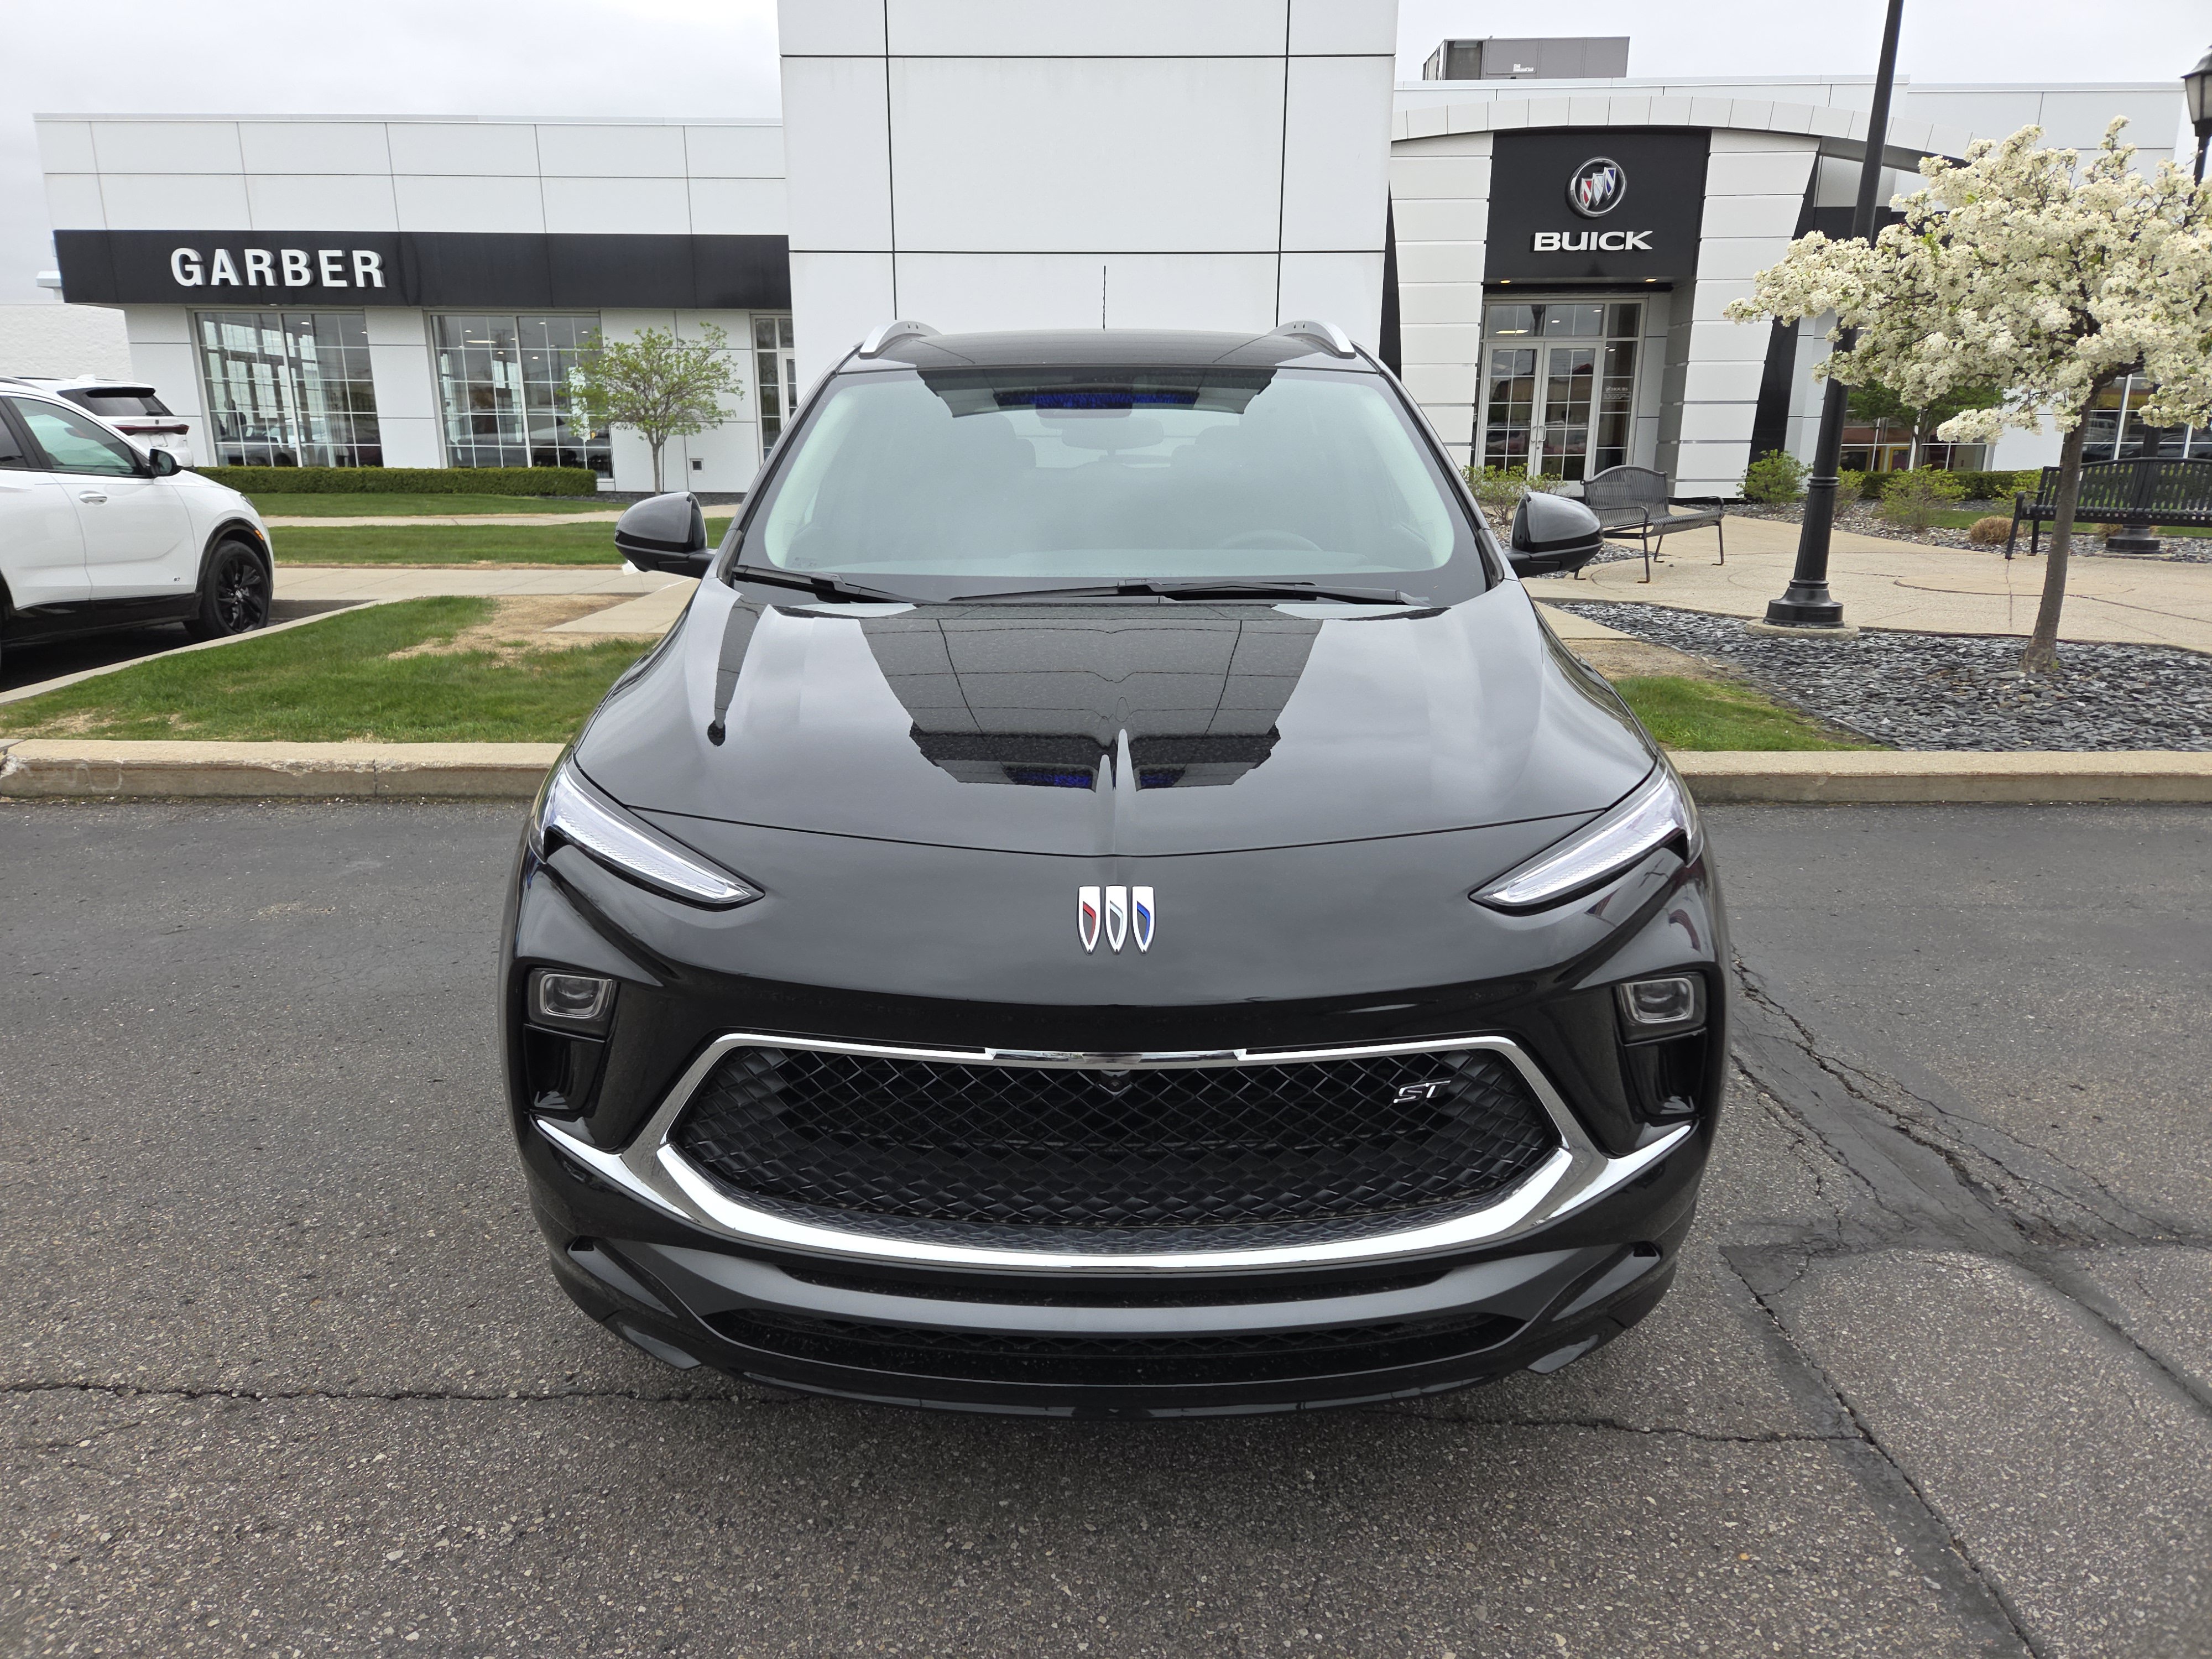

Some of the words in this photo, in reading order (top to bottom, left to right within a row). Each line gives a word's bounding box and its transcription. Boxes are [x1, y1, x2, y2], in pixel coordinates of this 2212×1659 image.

[1534, 231, 1653, 251] BUICK
[171, 248, 386, 287] GARBER
[1394, 1080, 1451, 1103] ST
